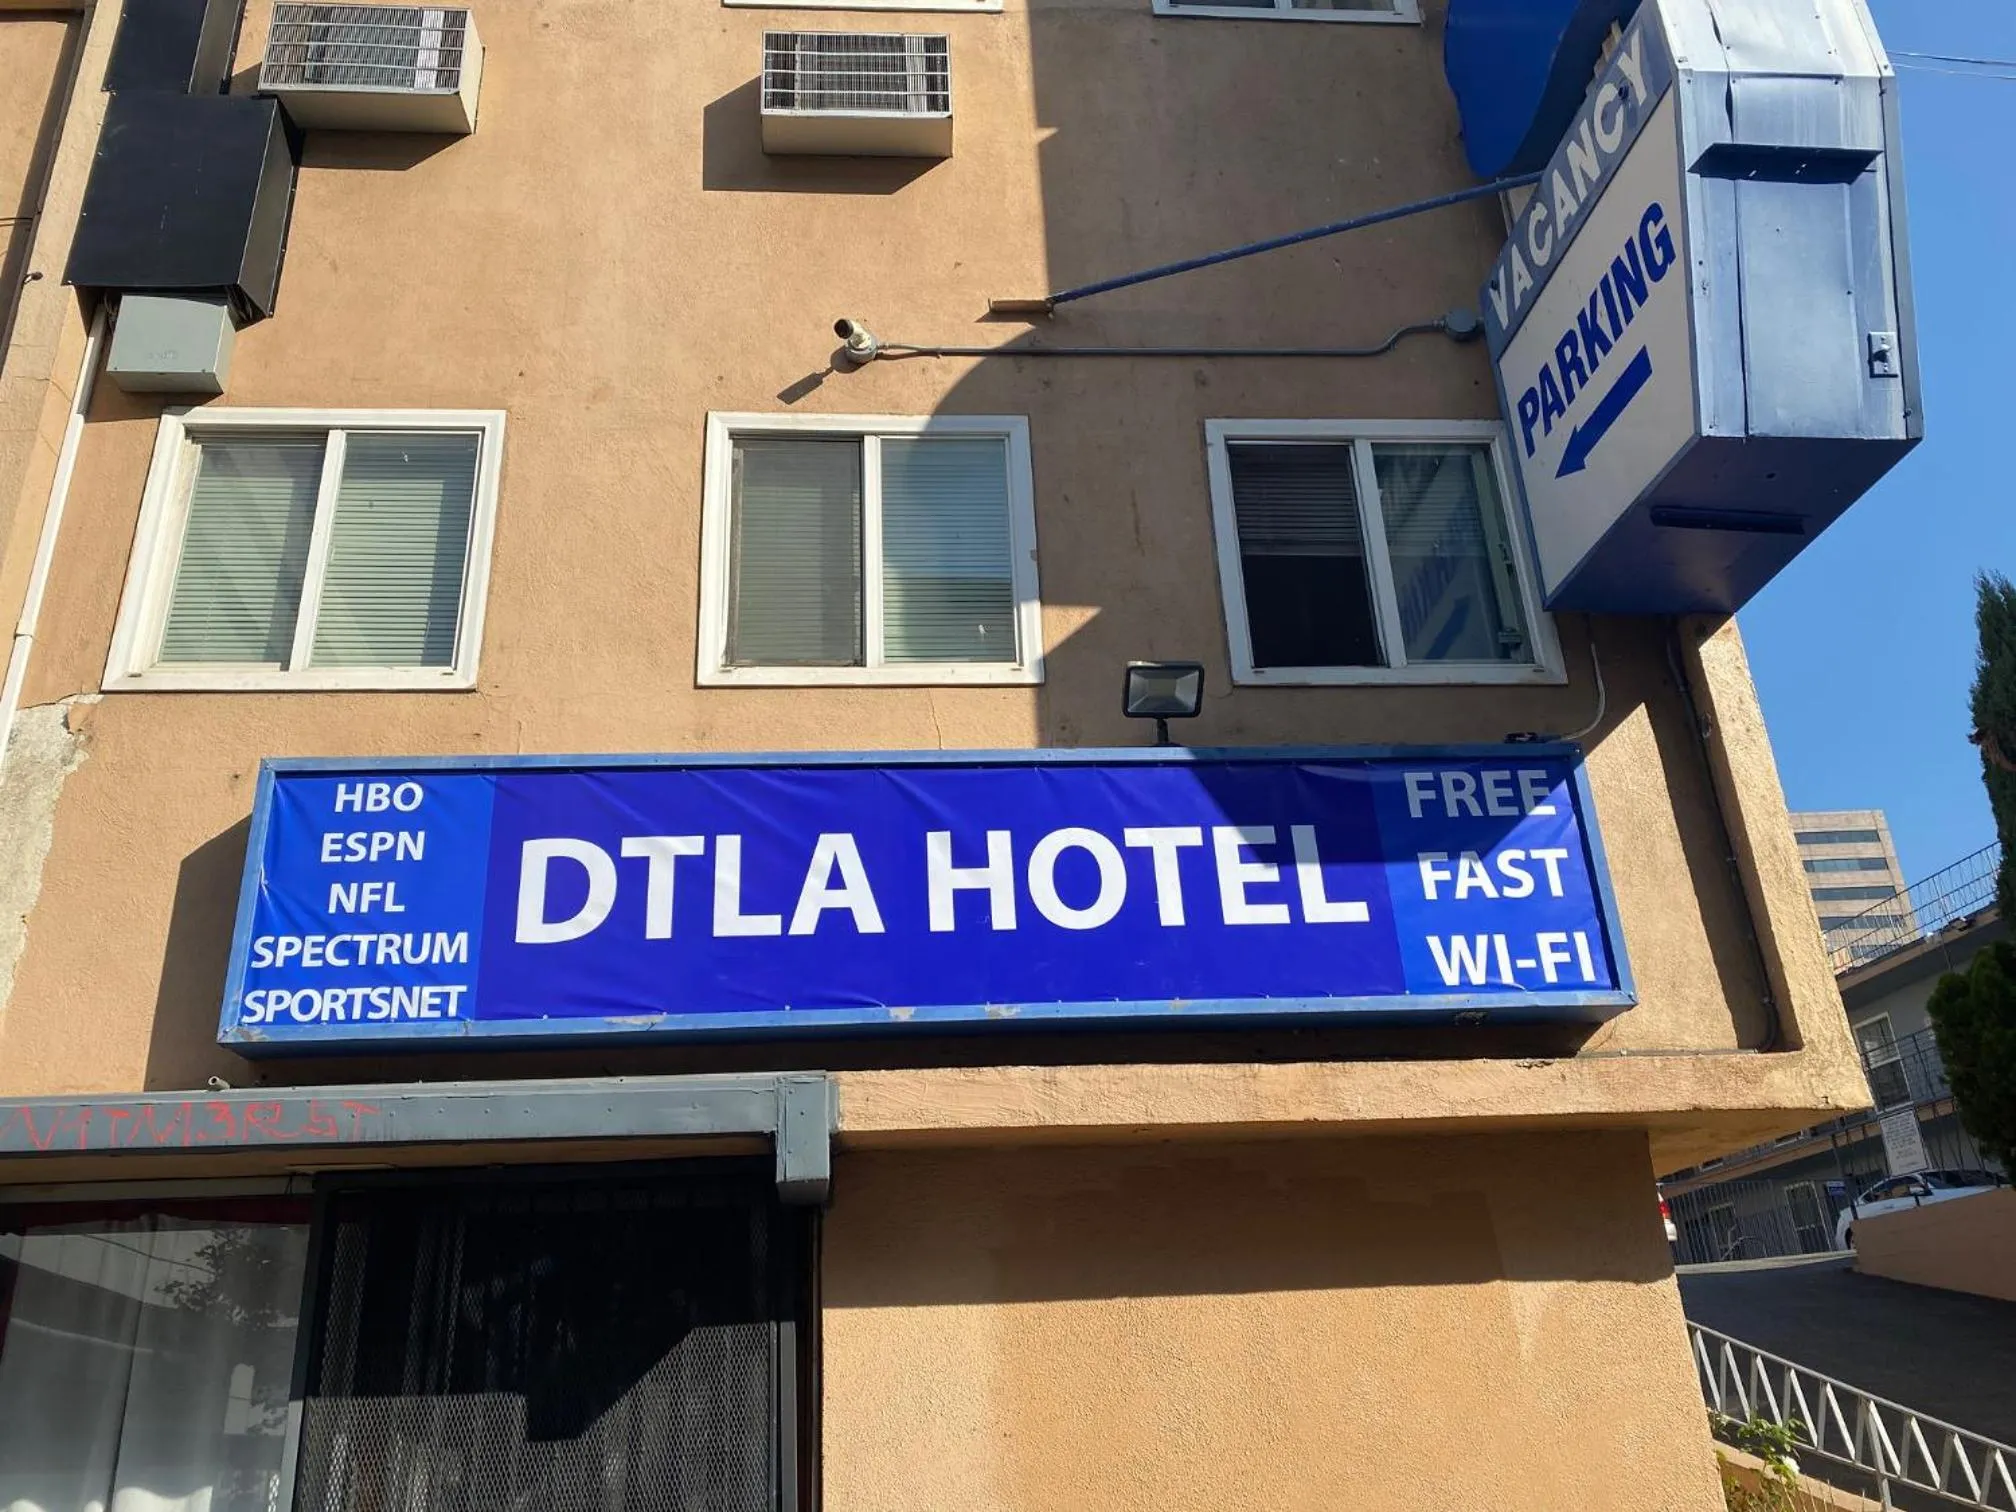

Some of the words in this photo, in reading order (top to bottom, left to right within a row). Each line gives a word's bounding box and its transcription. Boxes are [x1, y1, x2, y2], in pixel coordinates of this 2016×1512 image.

[1489, 28, 1647, 331] VACANCY
[1518, 203, 1676, 458] PARKING
[334, 782, 423, 813] HBO
[1404, 769, 1556, 818] FREE
[321, 831, 425, 863] ESPN
[328, 882, 405, 914] NFL
[515, 833, 886, 944] DTLA
[926, 825, 1370, 932] HOTEL
[1417, 848, 1568, 900] FAST
[251, 932, 468, 968] SPECTRUM
[1425, 931, 1597, 986] WI-FI
[241, 985, 467, 1024] SPORTSNET
